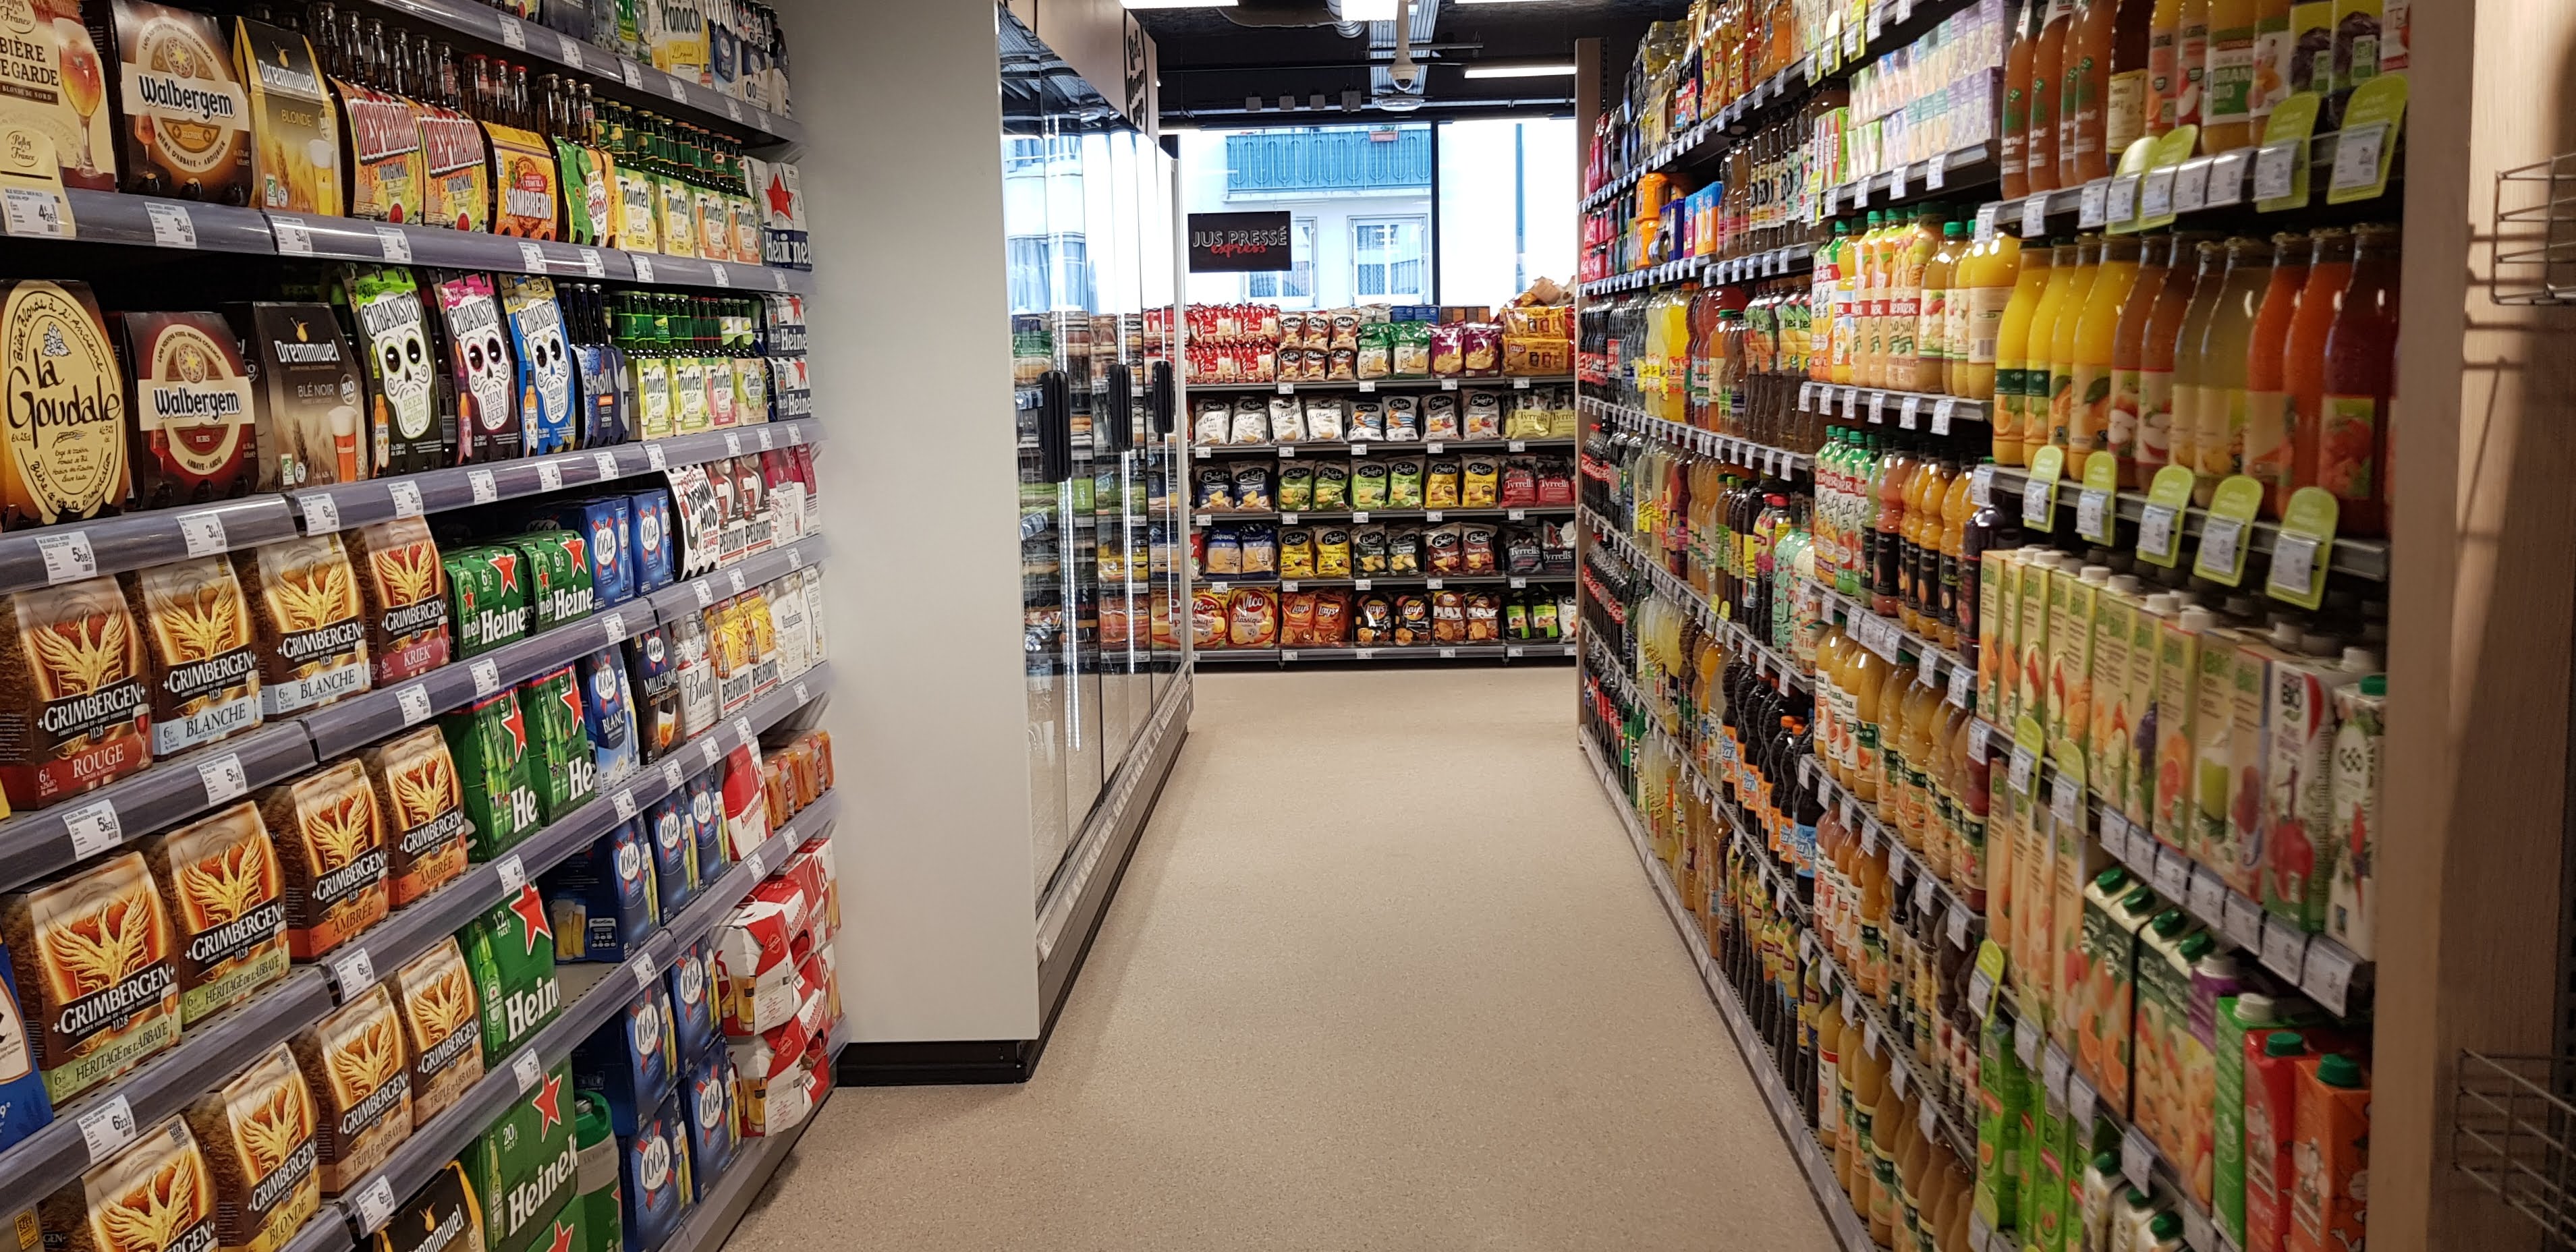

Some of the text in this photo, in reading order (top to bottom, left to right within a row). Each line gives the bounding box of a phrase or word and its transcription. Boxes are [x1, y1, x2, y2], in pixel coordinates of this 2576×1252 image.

[11, 64, 59, 87] GARDE
[258, 59, 320, 95] Dremmwel
[139, 74, 234, 119] Walbergem
[281, 107, 313, 128] BLONDE
[353, 101, 418, 156] DESPERADOS
[422, 117, 483, 169] DESPERADOS
[379, 161, 408, 182] ORIGINAL
[447, 174, 474, 194] ORIGINAL
[505, 188, 552, 220] SOMBRERO
[619, 181, 649, 209] Tourtel
[665, 190, 688, 216] Tourtel
[700, 197, 724, 224] Tourtel
[733, 205, 756, 228] Tourtel
[1193, 226, 1287, 248] JUS PRESSÉ
[1211, 243, 1268, 258] express
[362, 291, 420, 337] CUBANISTO
[449, 295, 497, 337] CUBANISTO
[517, 297, 559, 337] CUBANISTO
[274, 339, 341, 363] Dremmwel
[33, 347, 65, 390] la
[643, 371, 666, 393] Tourtel
[676, 369, 702, 392] Tourtel
[710, 369, 731, 389] Tourtel
[297, 382, 335, 398] BLÉ NOIR
[341, 381, 356, 395] BIO
[484, 391, 503, 405] RUM
[7, 365, 121, 450] Goudale
[153, 387, 240, 421] Walbergem
[403, 395, 422, 411] BEER
[486, 407, 505, 423] BEER
[549, 403, 565, 416] BEER
[30, 461, 48, 492] Bière
[700, 505, 717, 532] HUD
[596, 532, 617, 557] 1664
[642, 525, 659, 546] 1664
[554, 584, 594, 621] Heine
[1243, 594, 1263, 608] Vico
[1434, 606, 1463, 619] MAX
[385, 599, 444, 633] GRIMBERGEN
[480, 605, 526, 646] Heine
[282, 621, 362, 659] GRIMBERGEN
[648, 640, 663, 658] 1664
[404, 645, 432, 666] KRIEK
[169, 650, 253, 693] GRIMBERGEN
[300, 668, 356, 702] BLANCHE
[598, 672, 615, 696] 1664
[685, 669, 712, 708] Bud
[44, 682, 142, 733] GRIMBERGEN
[186, 703, 246, 739] BLANCHE
[602, 710, 625, 733] BLANC
[90, 724, 105, 740] 1128
[73, 743, 125, 778] ROUGE
[695, 795, 710, 817] 1664
[403, 810, 461, 854] GRIMBERGEN
[661, 818, 678, 843] 1664
[316, 850, 385, 901] GRIMBERGEN
[420, 855, 454, 887] AMBRÉE
[621, 849, 638, 877] 1664
[191, 902, 281, 961] GRIMBERGEN
[333, 901, 374, 937] AMBRÉE
[493, 910, 507, 932] 12
[235, 946, 249, 962] 1128
[205, 973, 244, 1005] HÉRITAGE
[681, 967, 702, 998] 1664
[60, 963, 171, 1034] GRIMBERGEN
[112, 1014, 130, 1032] 1128
[638, 1017, 654, 1049] 1664
[75, 1044, 123, 1082] HÉRITAGE
[133, 1020, 168, 1052] L'ABBAYE
[420, 1019, 478, 1073] GRIMBERGEN
[343, 1072, 405, 1135] GRIMBERGEN
[430, 1085, 451, 1108] TRIPLE
[702, 1090, 721, 1122] 1664
[503, 1122, 515, 1146] 20
[352, 1148, 376, 1170] TRIPLE
[644, 1149, 667, 1185] 1664
[252, 1141, 316, 1210] GRIMBERGEN
[269, 1197, 308, 1247] BLONDE
